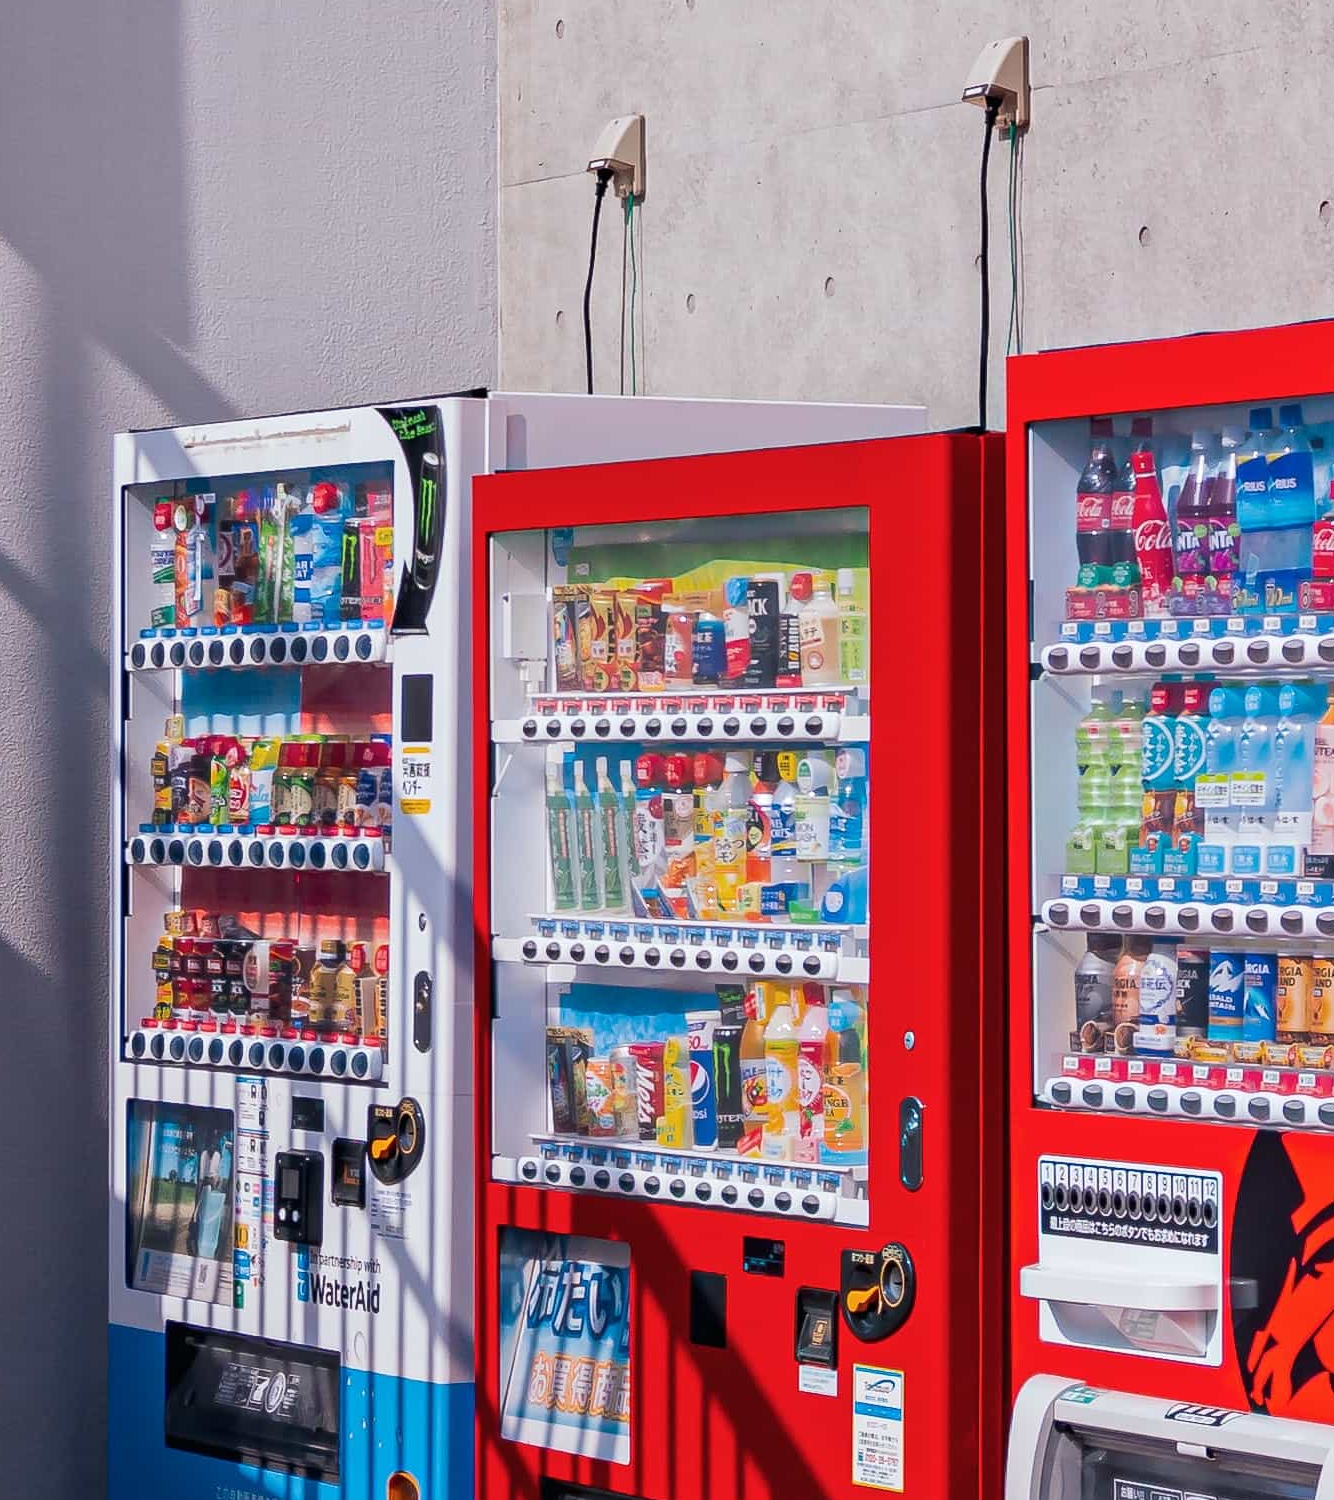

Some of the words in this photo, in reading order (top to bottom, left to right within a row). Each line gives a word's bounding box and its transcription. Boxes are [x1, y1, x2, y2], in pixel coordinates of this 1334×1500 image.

[1045, 1166, 1050, 1180] 1
[1059, 1167, 1065, 1181] 2
[1073, 1169, 1079, 1182] 3
[1087, 1170, 1094, 1184] 4
[1102, 1171, 1108, 1185] 5
[1117, 1172, 1123, 1186] 6
[1132, 1174, 1138, 1187] 7
[1147, 1176, 1153, 1189] 8
[1162, 1177, 1168, 1191] 9
[1175, 1178, 1186, 1193] 10
[1191, 1180, 1199, 1194] 11
[1205, 1181, 1216, 1195] 12
[364, 1257, 381, 1273] with
[310, 1273, 381, 1314] WaterAid
